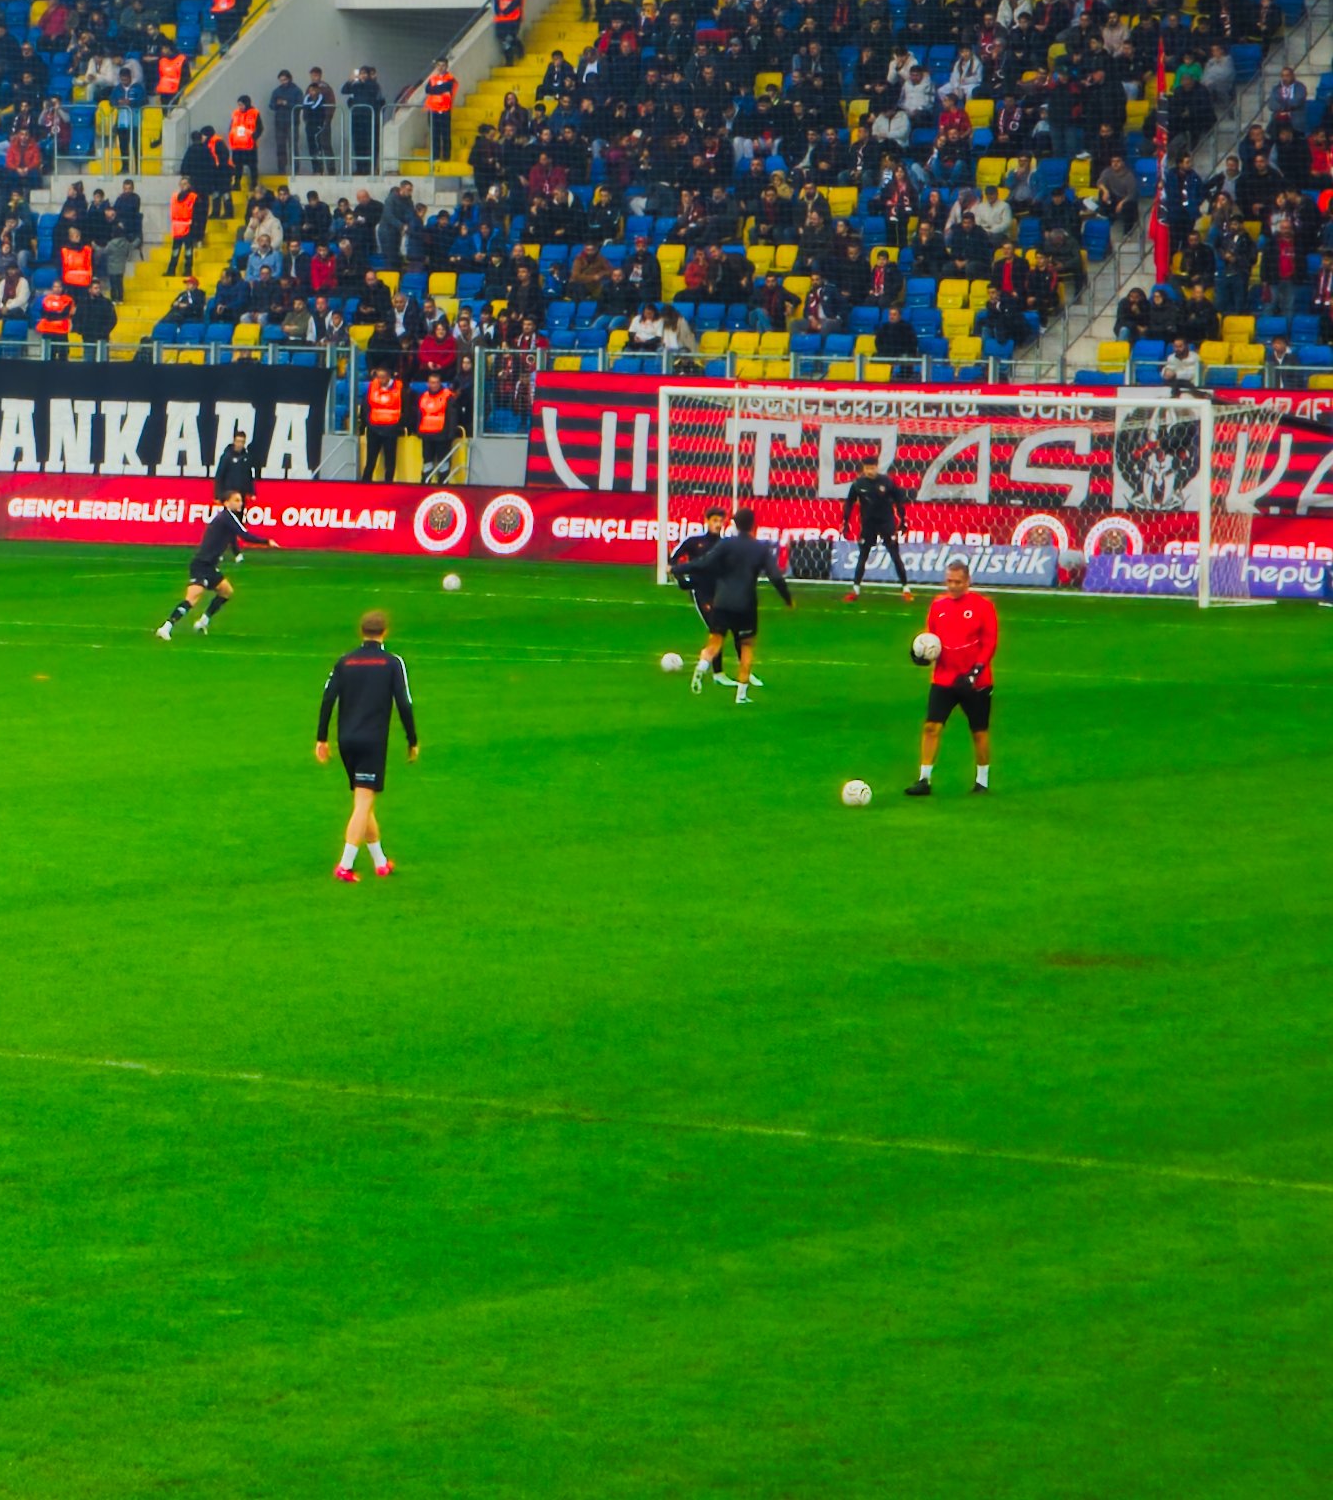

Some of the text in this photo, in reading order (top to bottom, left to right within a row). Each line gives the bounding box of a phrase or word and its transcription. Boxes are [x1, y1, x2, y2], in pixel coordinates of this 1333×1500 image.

[7, 496, 185, 524] GENÇLERBİRLİĞİ
[189, 502, 277, 527] FUOL
[281, 506, 396, 531] OKULLARI
